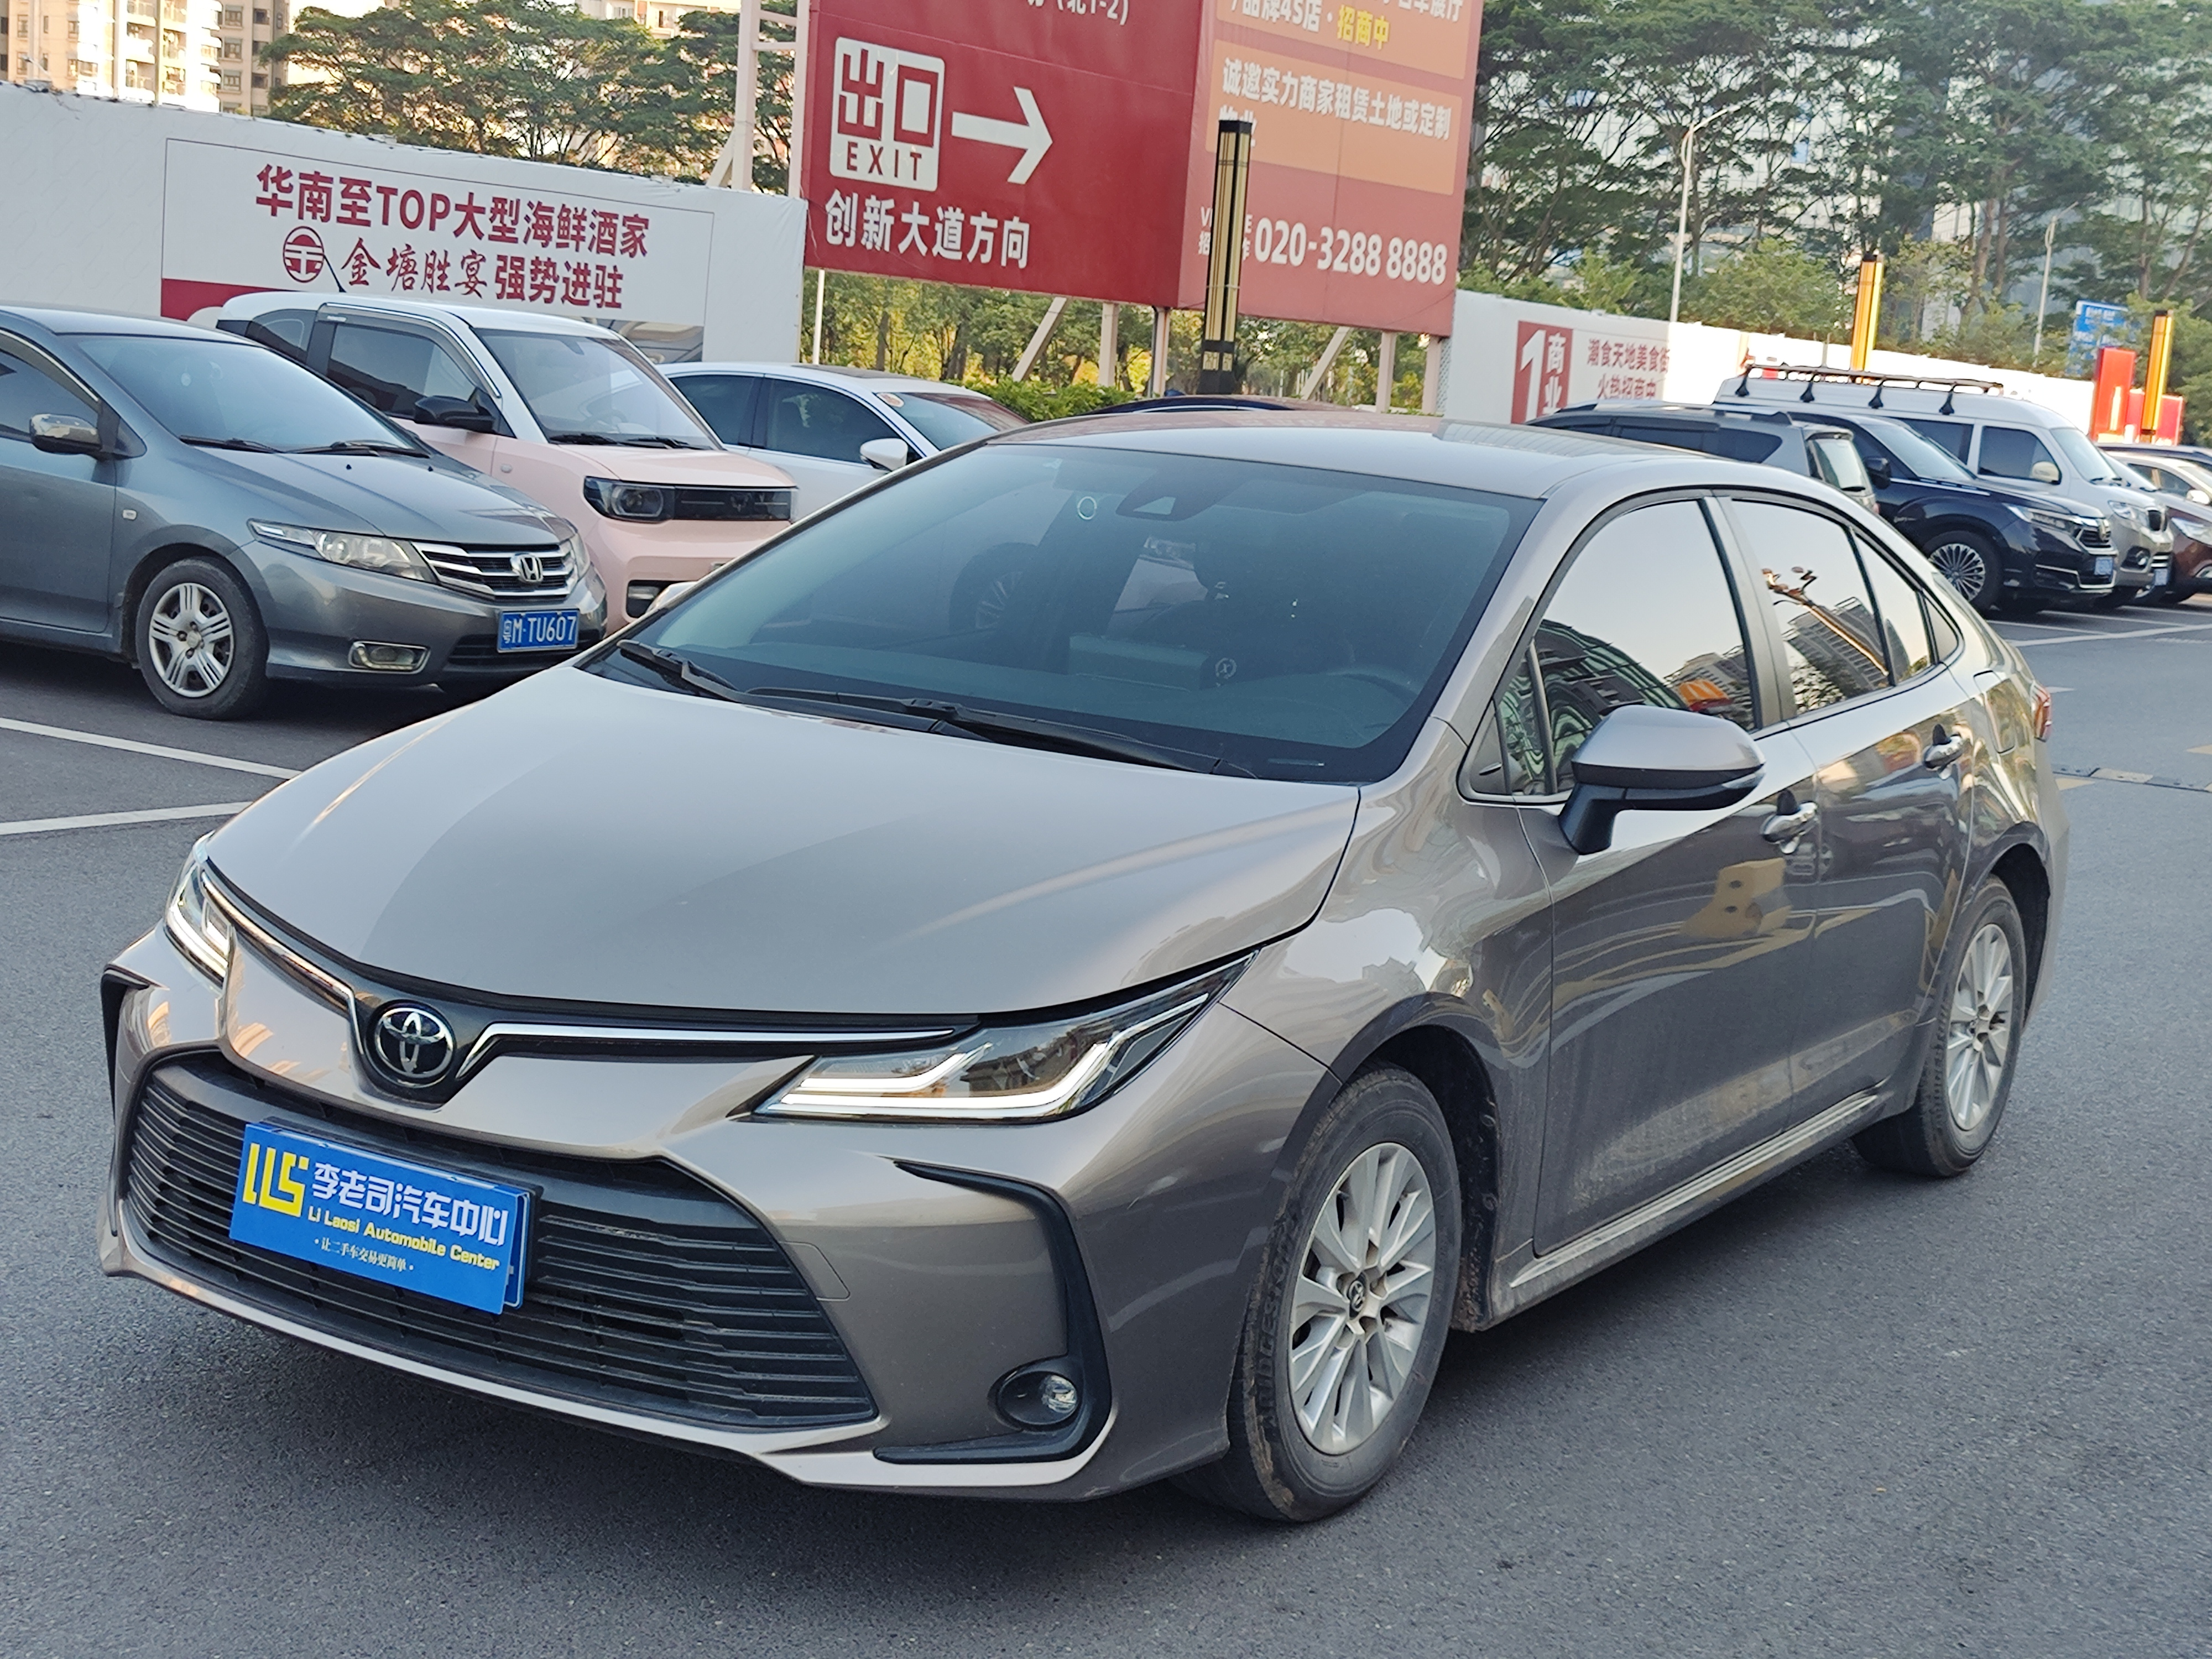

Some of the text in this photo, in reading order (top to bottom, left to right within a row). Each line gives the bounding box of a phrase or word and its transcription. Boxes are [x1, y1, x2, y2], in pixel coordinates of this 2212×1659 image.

[838, 49, 938, 147] 出口
[1222, 58, 1452, 141] 诚邀实力商家租赁土地或定制
[847, 141, 922, 181] EXIT
[256, 164, 650, 258] 华南至TOP大型海鲜酒家
[825, 189, 1031, 269] 创新大道方向
[1254, 217, 1382, 276] 020-3288
[1386, 237, 1448, 285] 8888
[308, 1206, 500, 1271] Li Laosi Automobile Center
[312, 1162, 509, 1246] 李老司汽车中心
